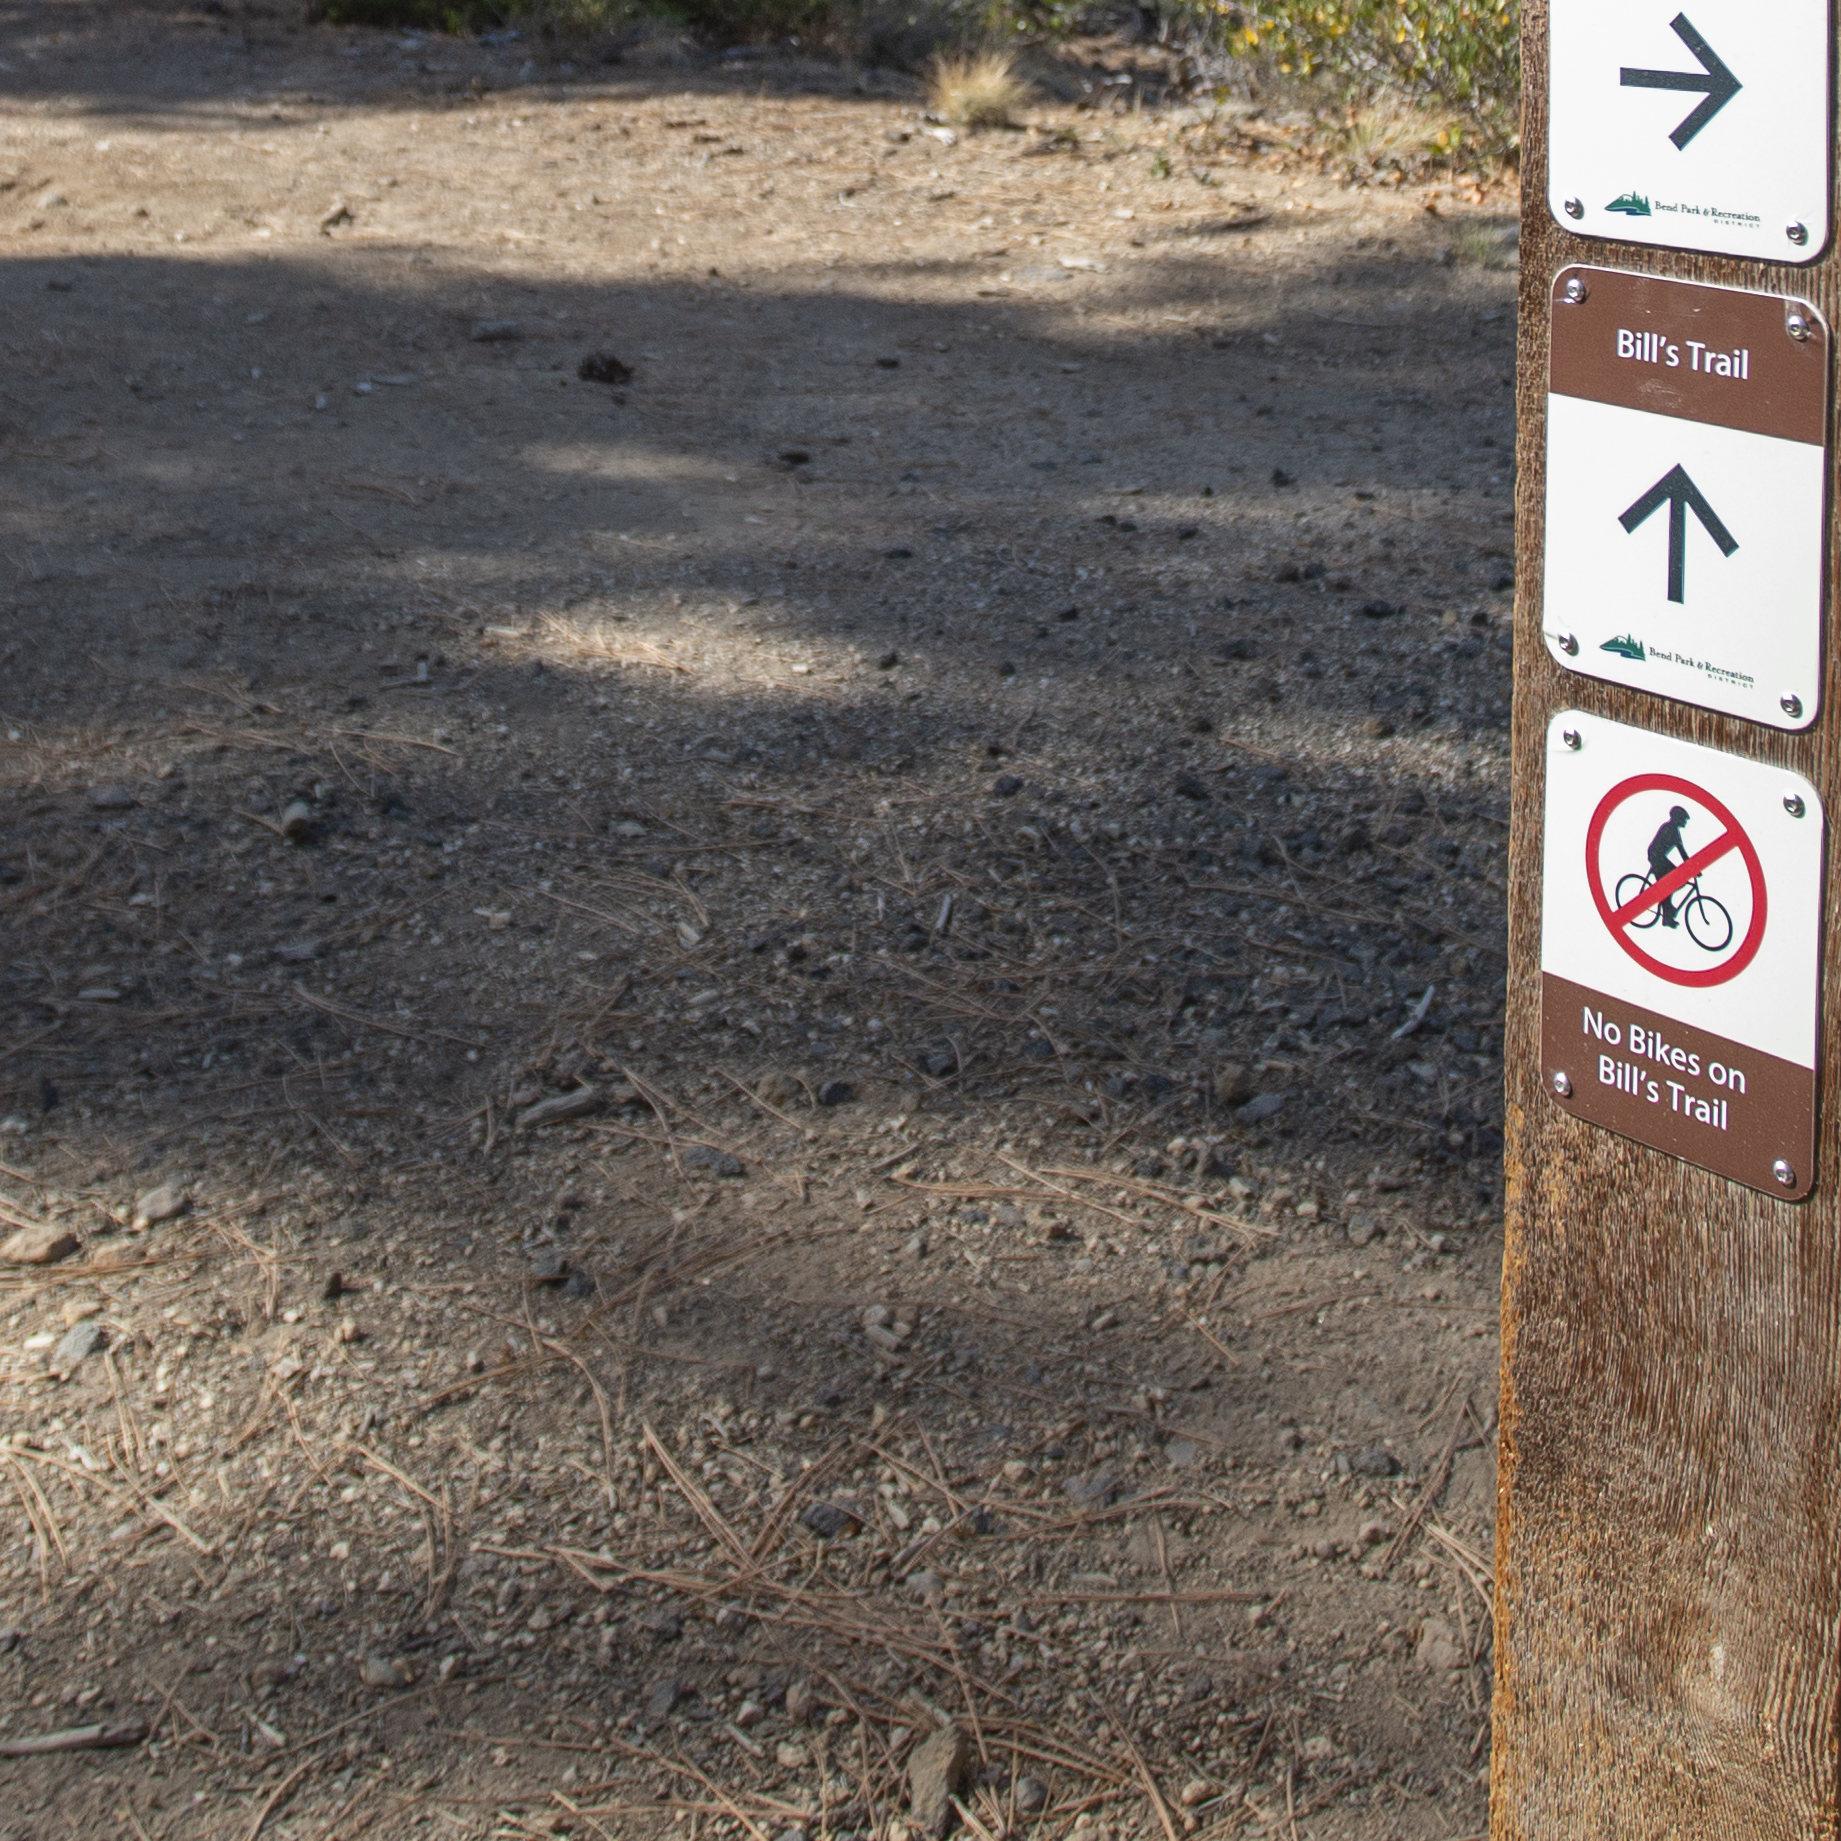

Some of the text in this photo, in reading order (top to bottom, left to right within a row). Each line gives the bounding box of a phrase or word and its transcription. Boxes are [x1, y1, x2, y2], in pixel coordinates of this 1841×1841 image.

[1654, 200, 1760, 222] Bend Park & Recreation
[1616, 328, 1749, 380] Bill's Trail
[1649, 647, 1754, 683] Bend Park & Recreation
[1583, 1006, 1747, 1094] No Bikes on
[1599, 1054, 1727, 1131] Bill's Trail
